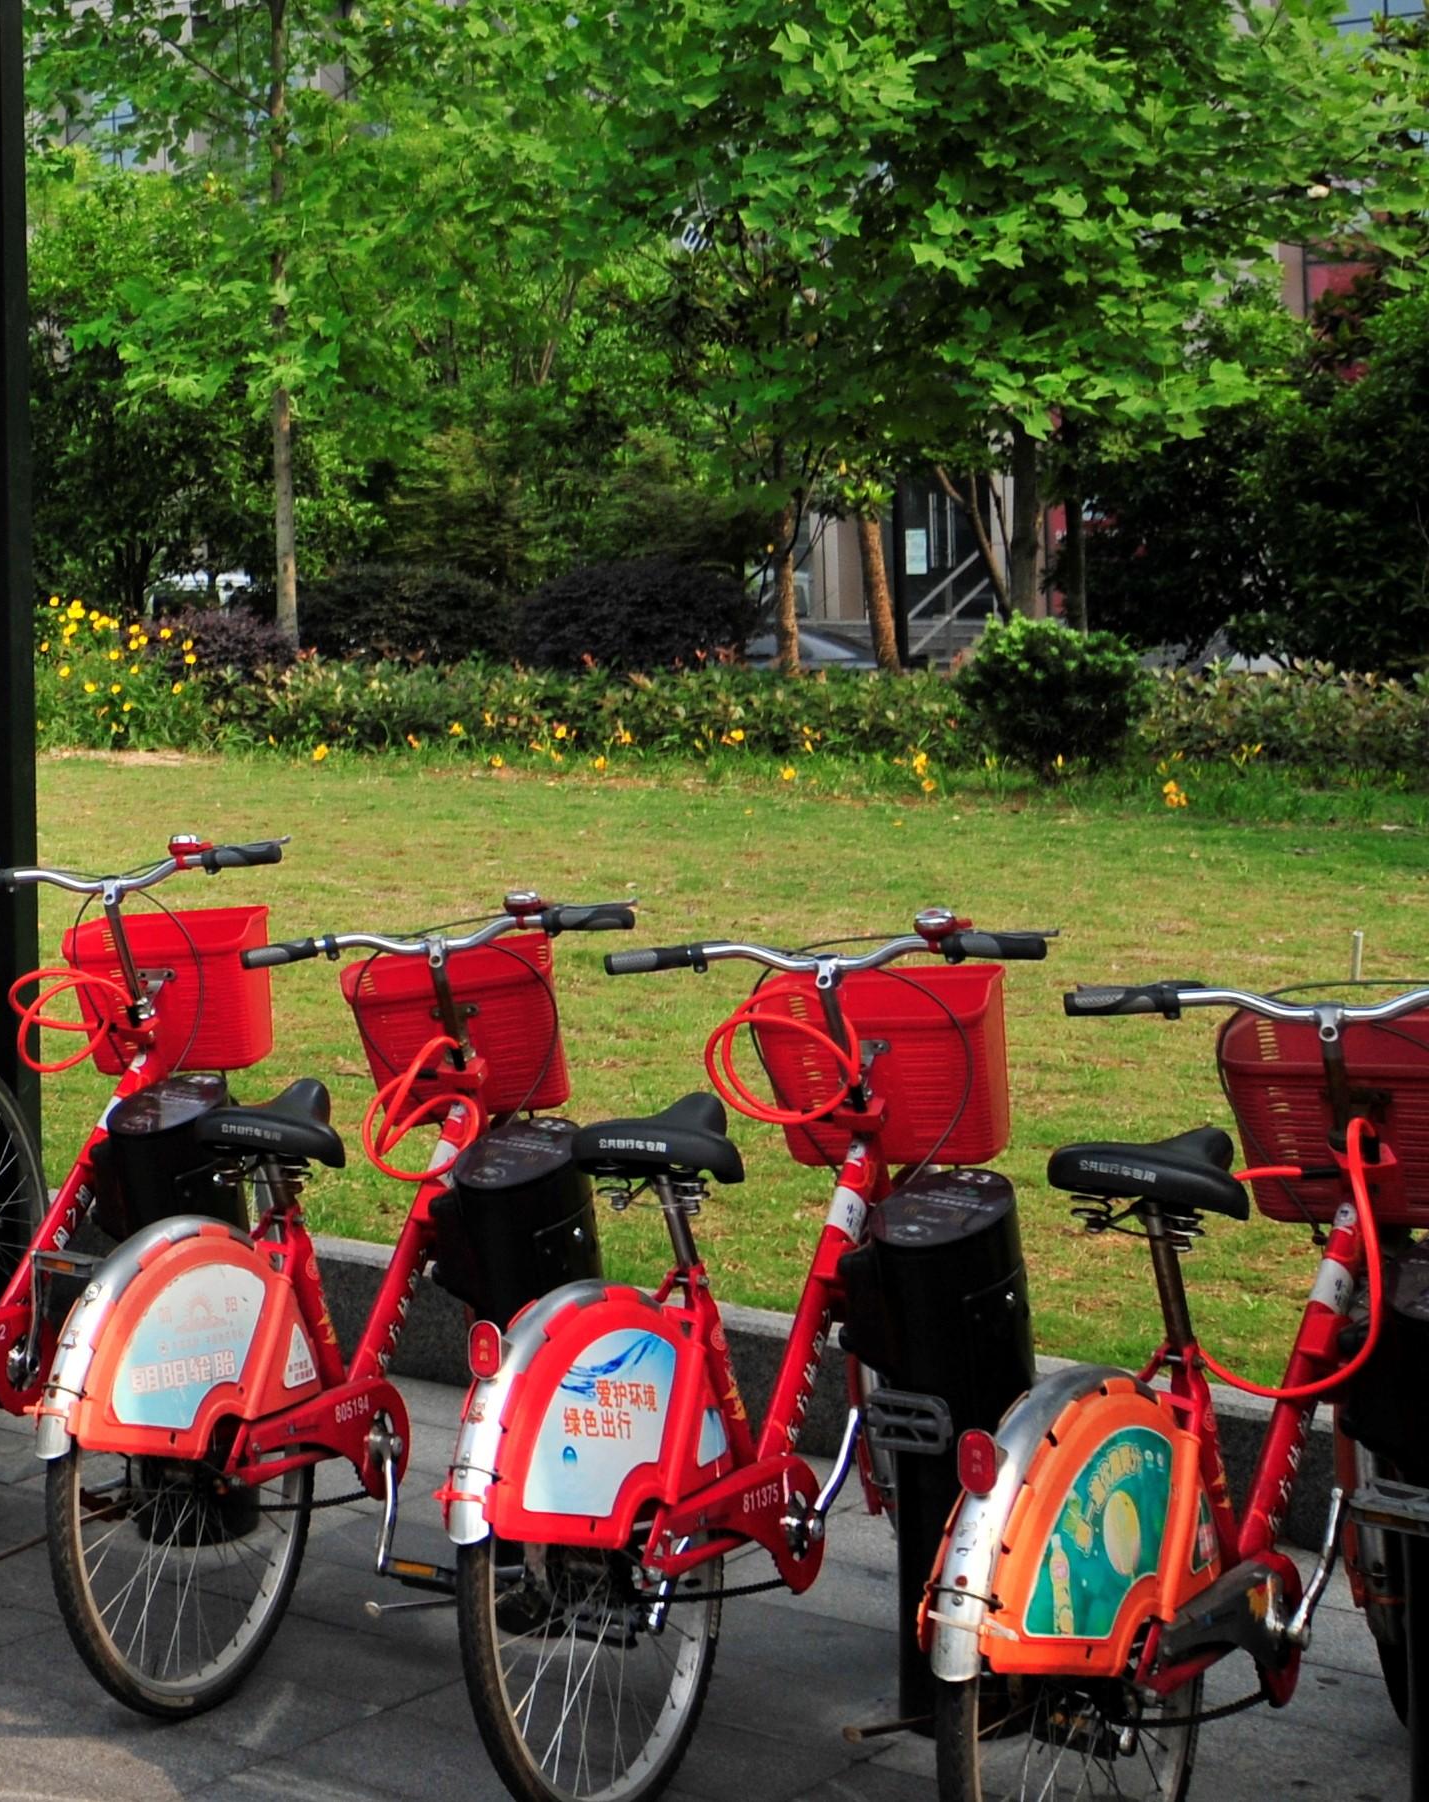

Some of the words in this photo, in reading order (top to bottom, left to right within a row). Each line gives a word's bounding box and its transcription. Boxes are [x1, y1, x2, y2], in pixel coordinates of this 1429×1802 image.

[956, 1171, 992, 1184] 23
[595, 1379, 659, 1413] 爱护环境
[334, 1399, 371, 1424] 805194
[562, 1406, 633, 1440] 绿色出行
[741, 1486, 780, 1514] 811375
